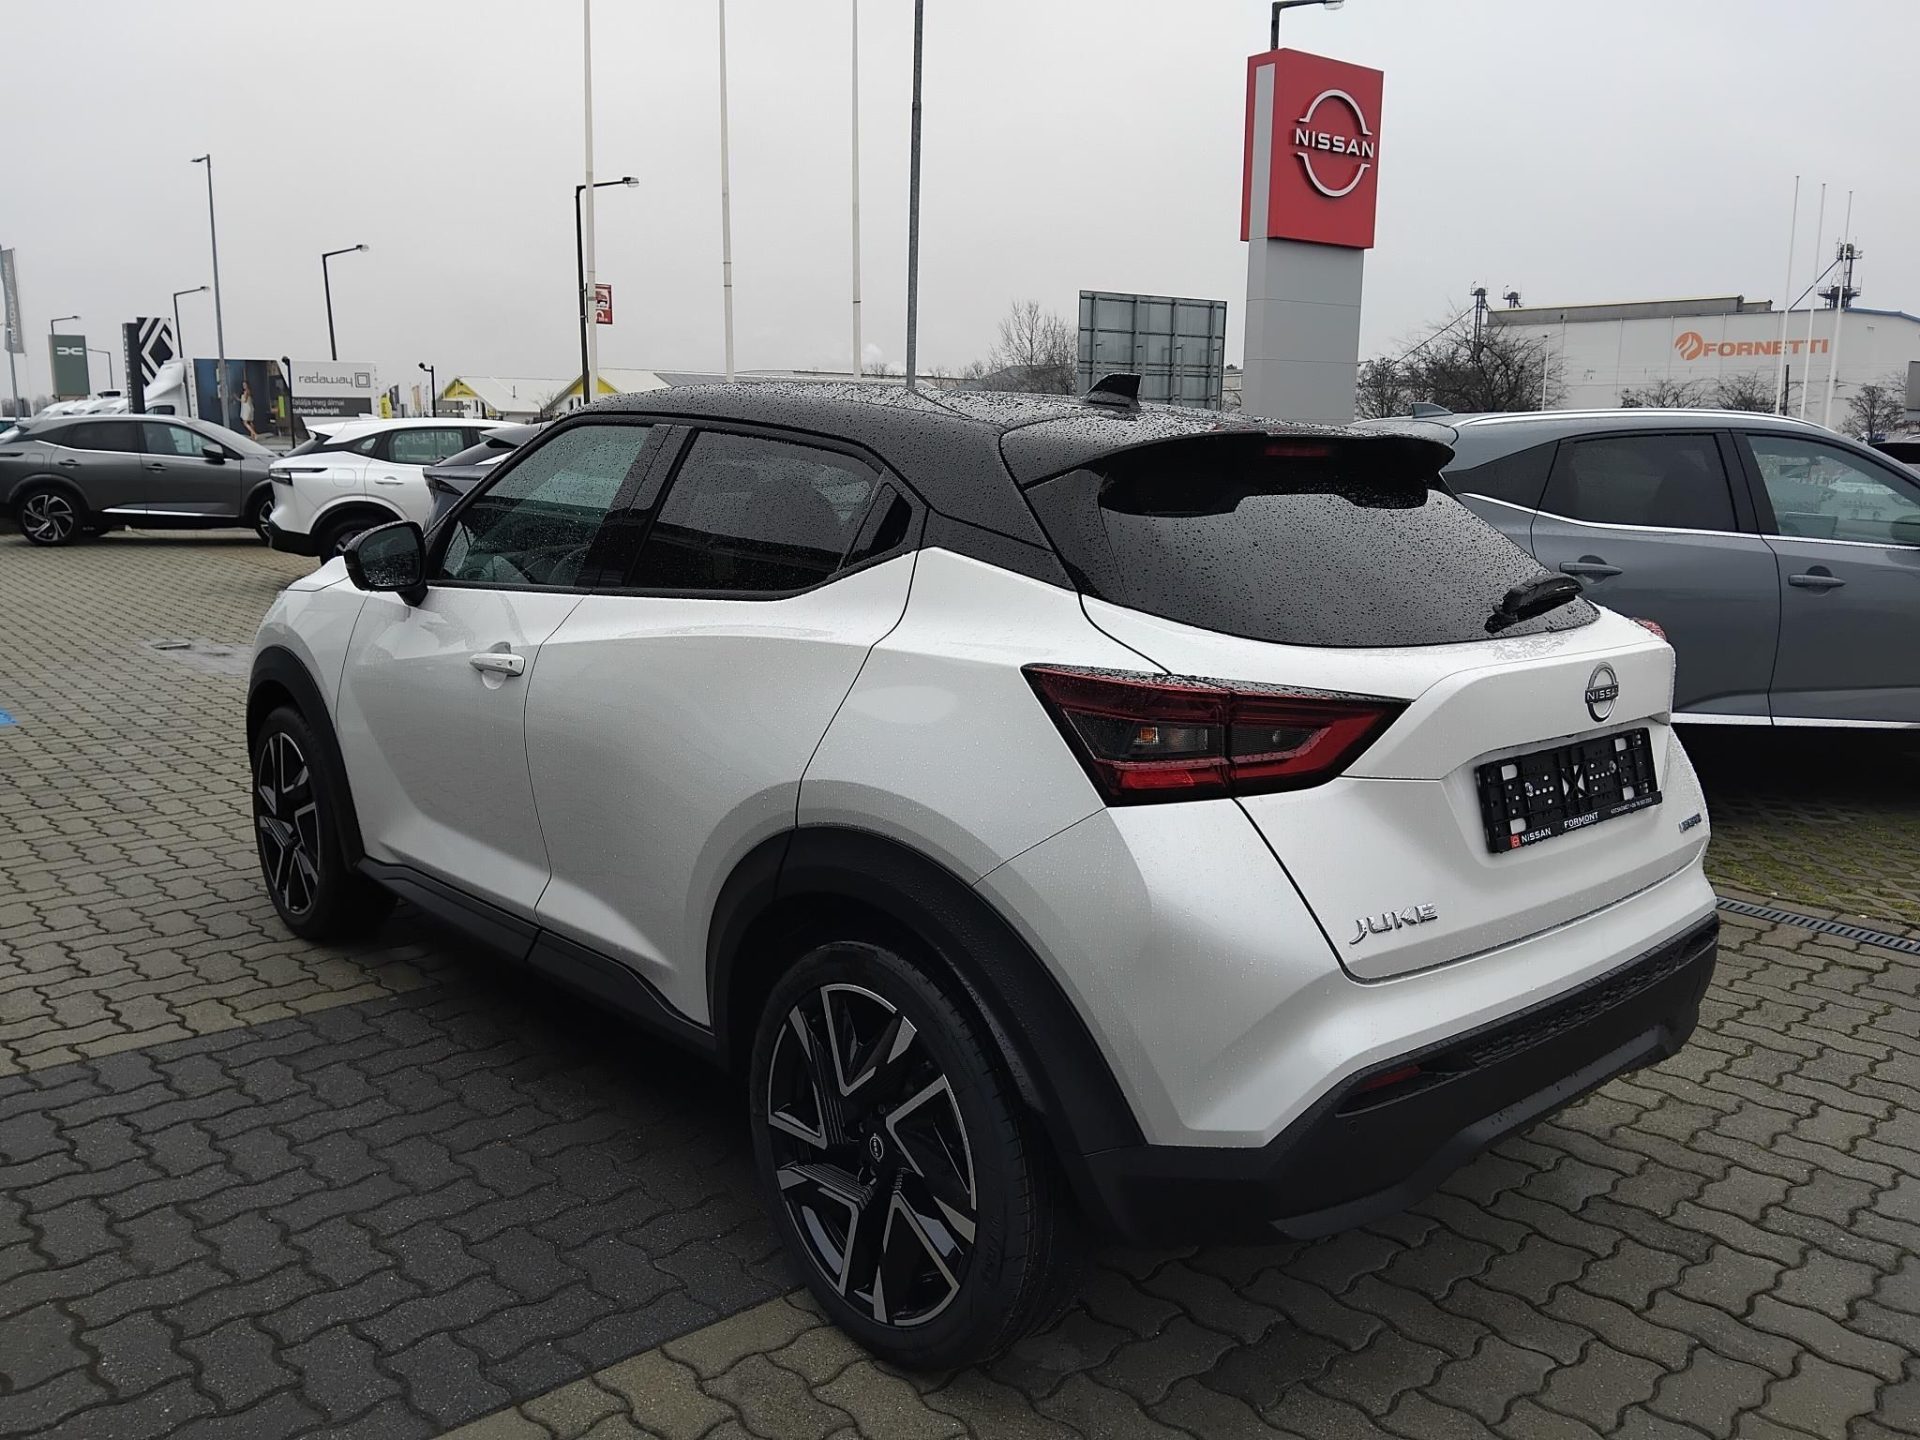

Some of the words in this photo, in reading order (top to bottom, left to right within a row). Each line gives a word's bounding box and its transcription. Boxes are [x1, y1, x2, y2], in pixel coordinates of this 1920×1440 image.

[1296, 128, 1374, 158] NISSAN
[1703, 339, 1829, 357] FORNETTI
[299, 372, 354, 387] radaway
[1564, 812, 1598, 829] FORMONT
[1521, 828, 1551, 843] NISSAN
[1349, 903, 1438, 945] JUKE
